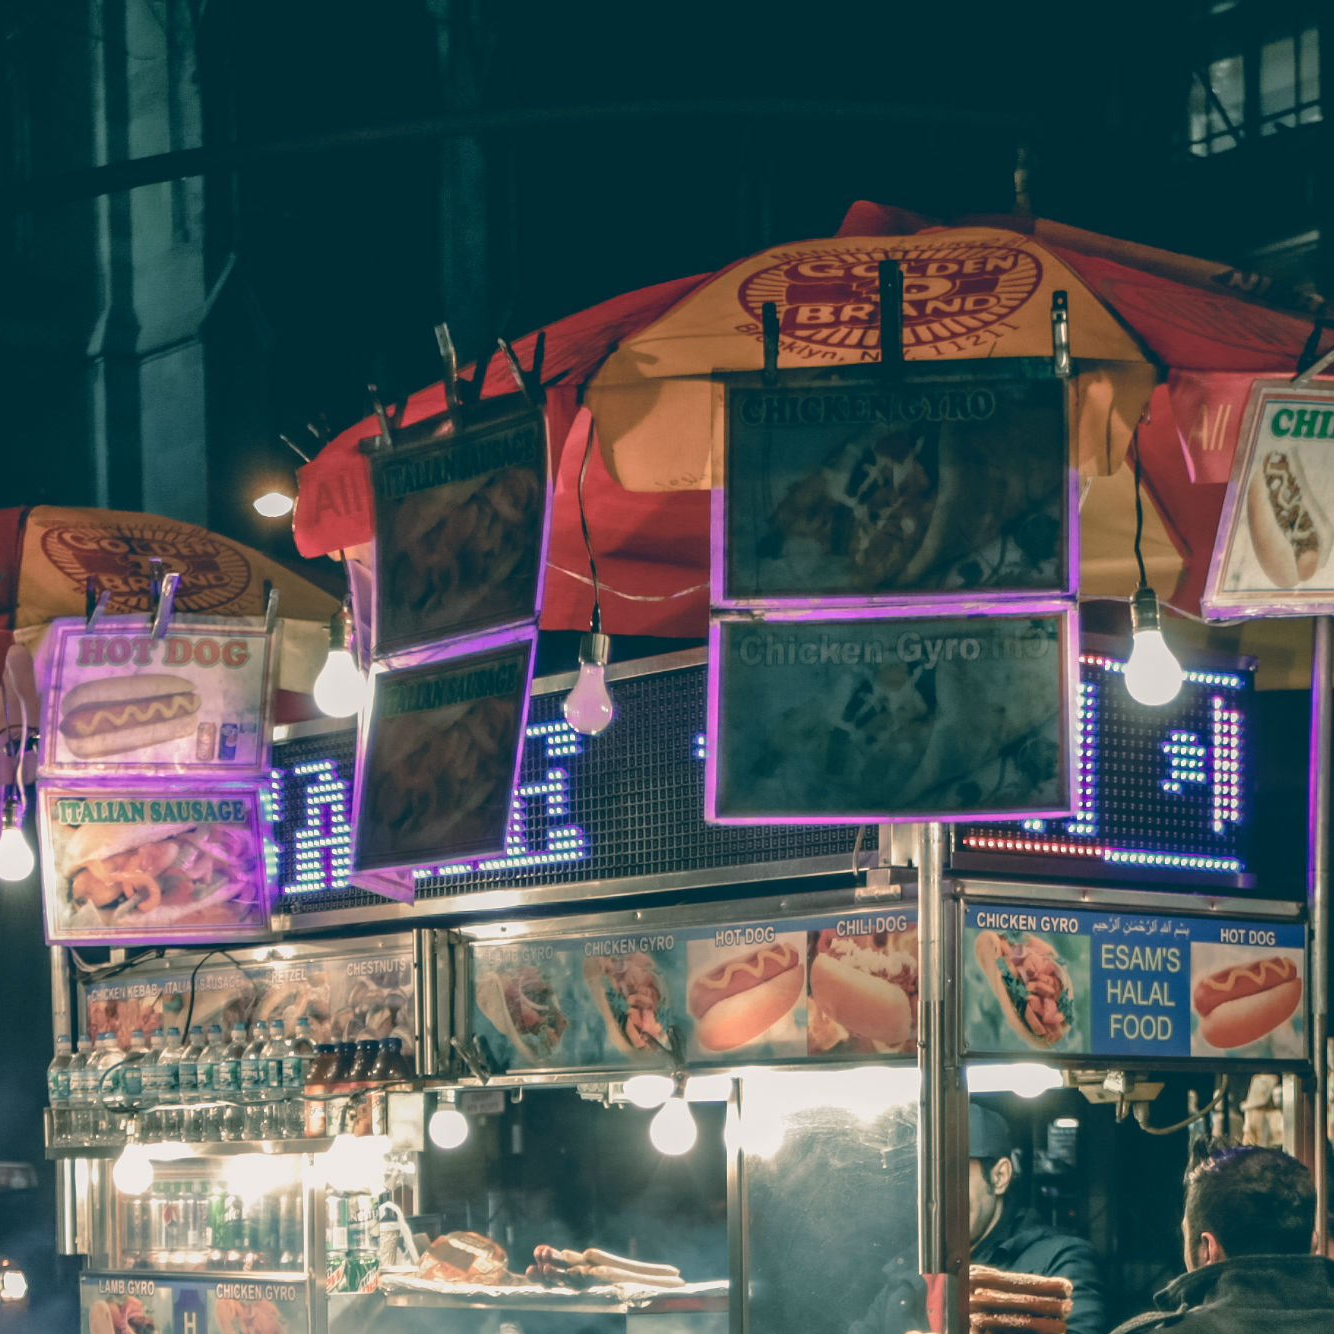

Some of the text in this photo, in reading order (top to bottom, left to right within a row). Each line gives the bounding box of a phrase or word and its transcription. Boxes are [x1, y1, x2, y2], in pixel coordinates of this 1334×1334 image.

[797, 254, 1017, 279] GOLDEN
[929, 322, 1020, 356] 11211
[739, 389, 997, 425] CHICKEN GYRO
[98, 571, 232, 594] BRND
[78, 636, 250, 668] HOT DOG
[739, 633, 884, 666] Chicken
[895, 632, 981, 671] Gyro
[56, 799, 246, 827] ITALIAN SAUSAGE
[836, 915, 907, 937] CHILI DOG
[977, 911, 1079, 934] CHICKEN GYRO
[584, 934, 675, 956] CHICKEN GYRO
[714, 926, 776, 947] HOT DOG
[1219, 928, 1276, 946] HOT DOG
[522, 946, 555, 962] GYRO
[1101, 943, 1181, 974] ESAM'S
[346, 961, 407, 978] CHESTNUTS
[91, 982, 158, 1001] CHICKEN KEBAB
[200, 974, 242, 992] SAUSAGE
[1107, 979, 1176, 1008] HALAL
[1110, 1013, 1173, 1042] FOOD
[99, 1279, 155, 1297] LAMB GYRO
[216, 1282, 296, 1302] CHICKEN GYRO
